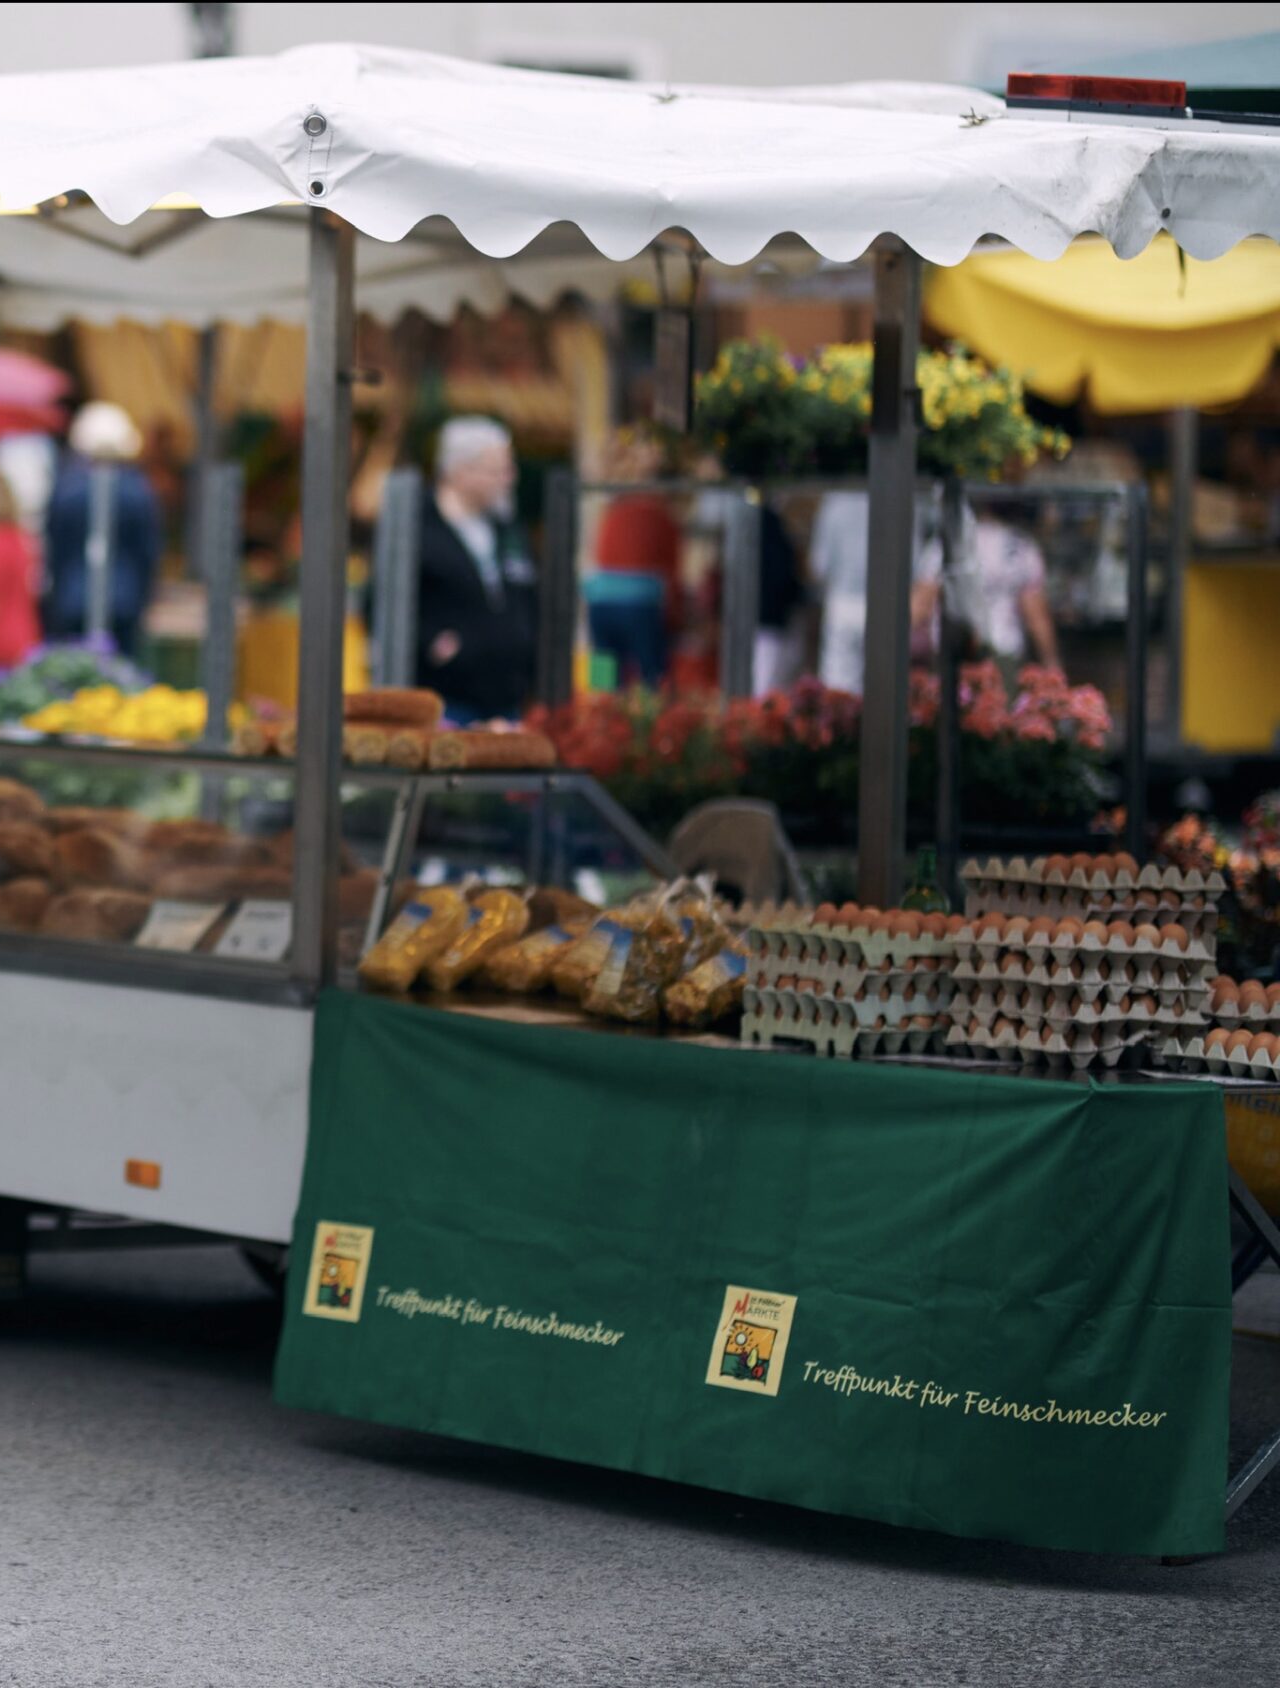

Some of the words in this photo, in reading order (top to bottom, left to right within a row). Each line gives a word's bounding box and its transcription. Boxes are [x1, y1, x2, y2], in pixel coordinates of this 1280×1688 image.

[376, 1286, 462, 1319] Treffpunkt
[461, 1298, 493, 1325] für
[493, 1305, 625, 1346] Feinschmecker
[803, 1361, 919, 1400] Treffpunkt
[920, 1381, 959, 1408] für
[964, 1391, 1167, 1427] Feinschmecker
